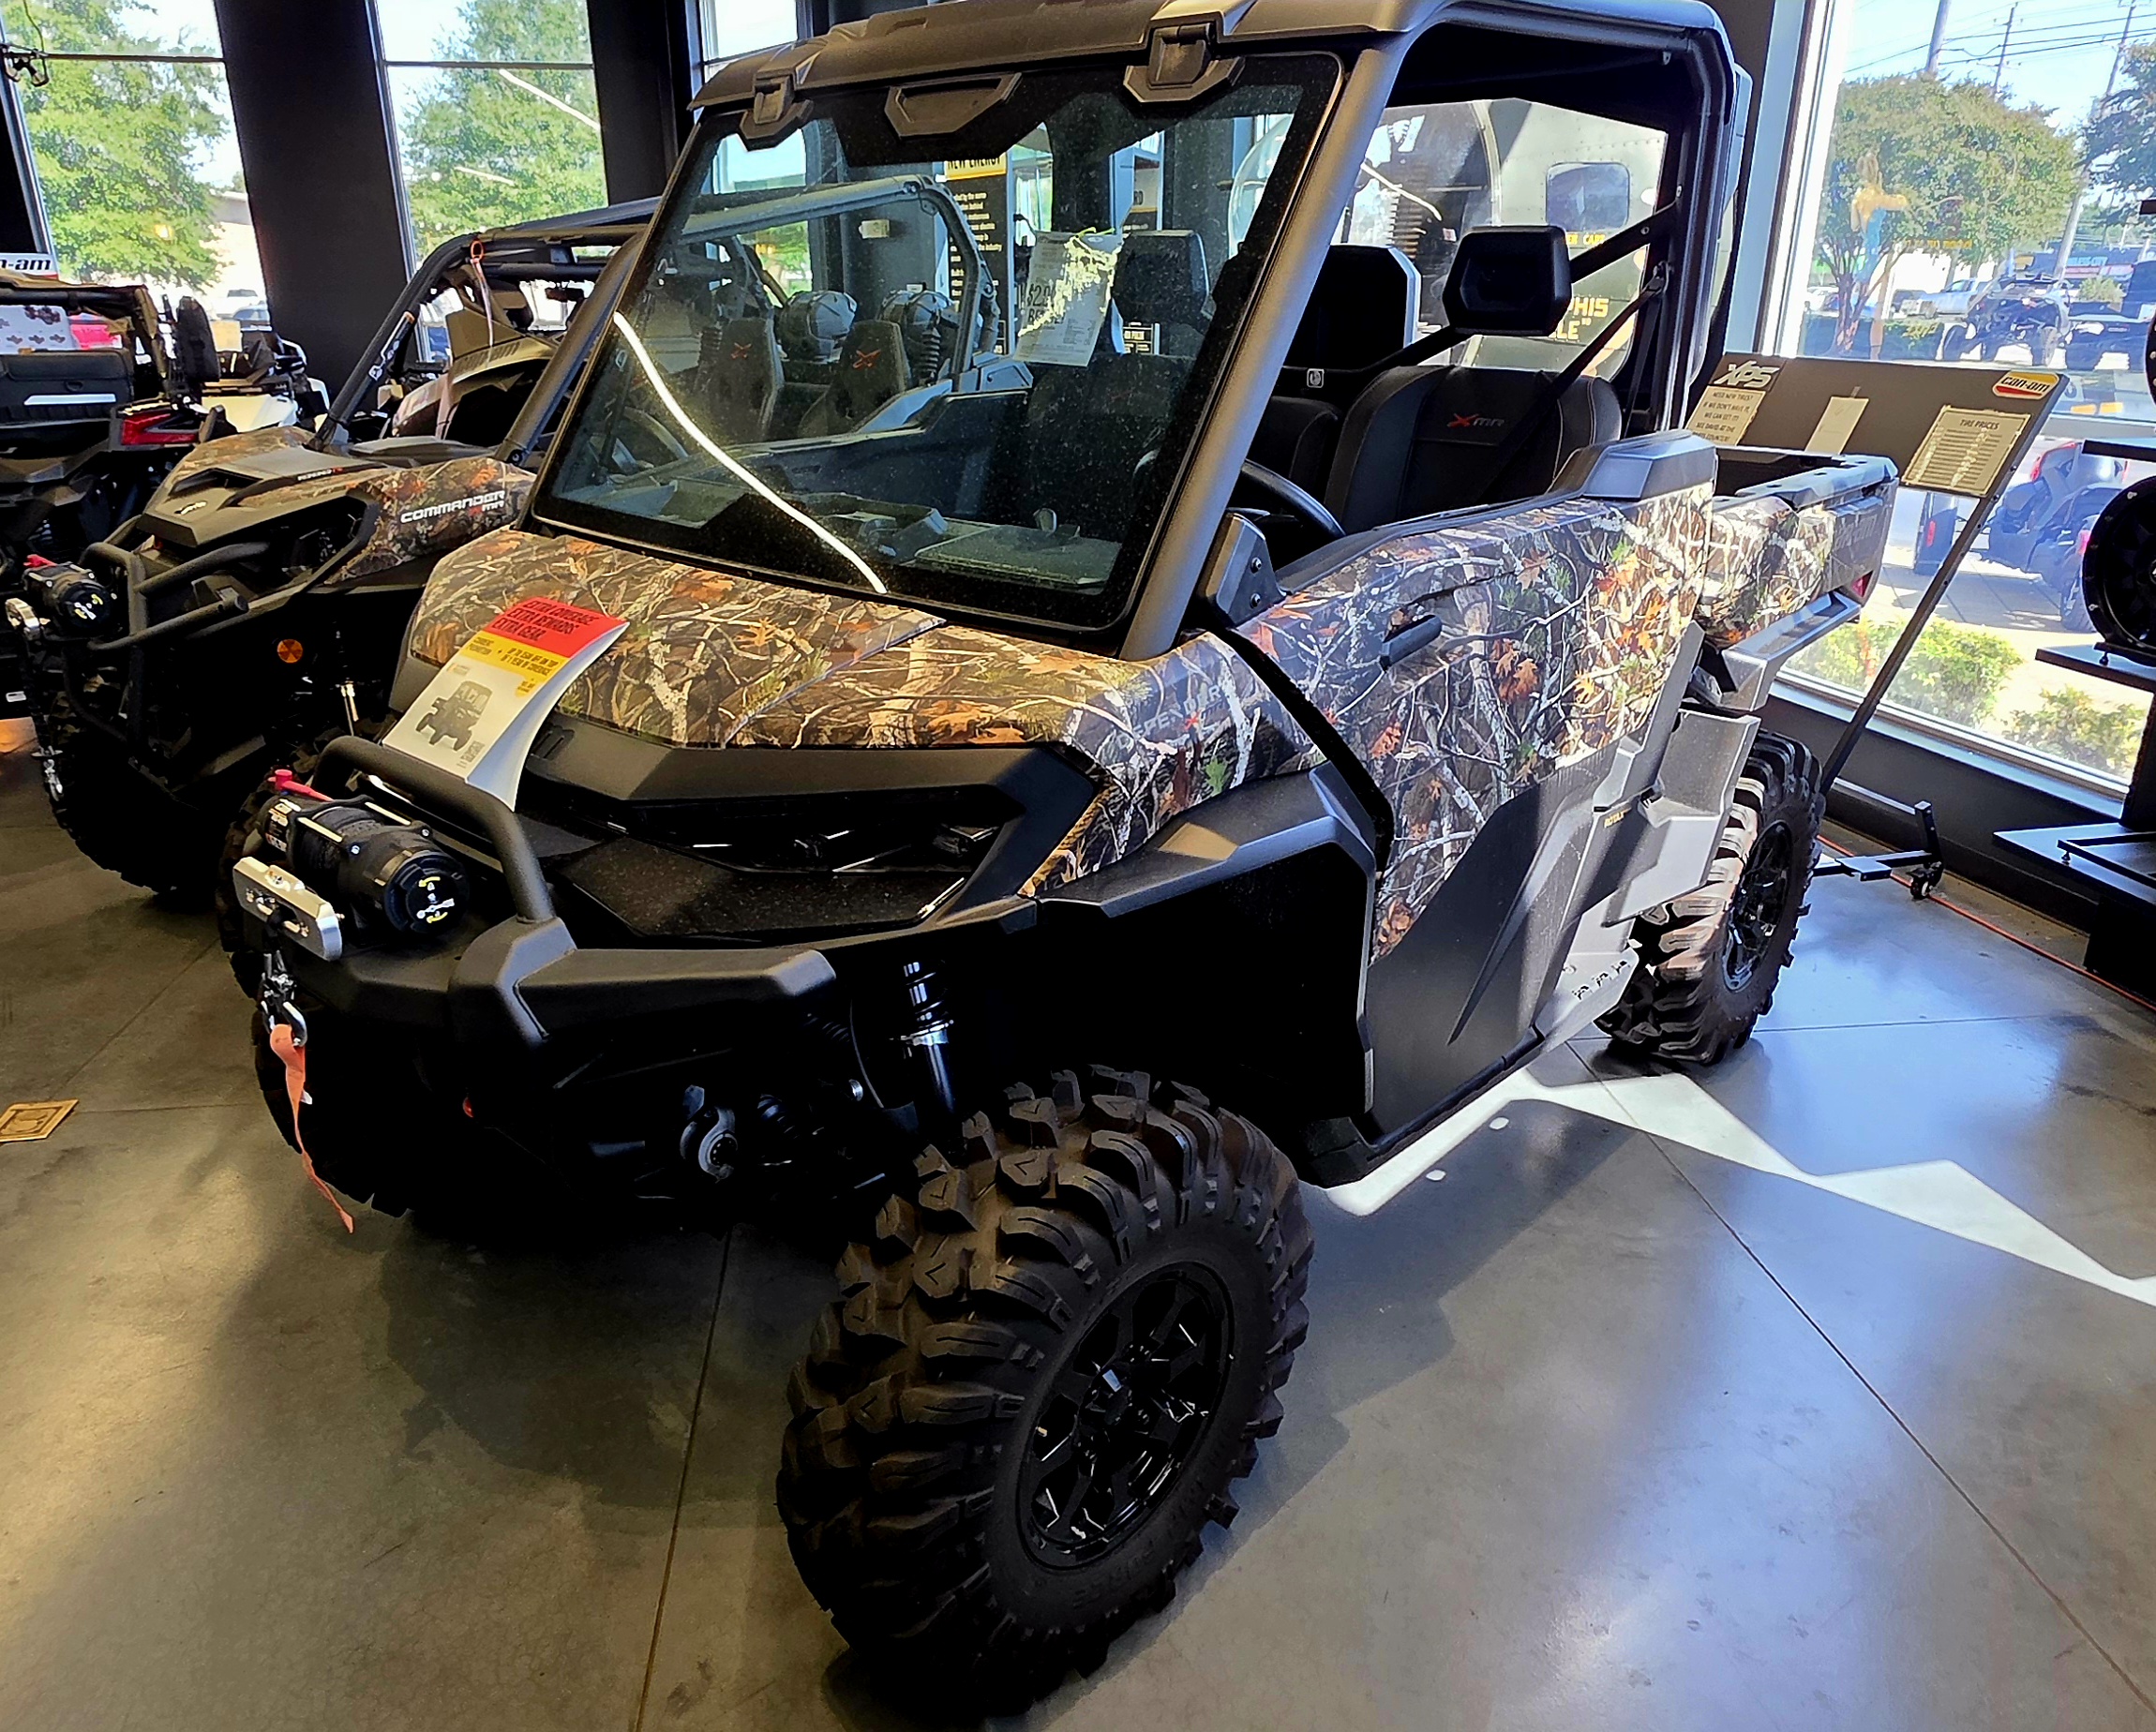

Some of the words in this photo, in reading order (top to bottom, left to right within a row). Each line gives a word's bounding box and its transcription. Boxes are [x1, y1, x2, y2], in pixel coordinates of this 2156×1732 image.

[1569, 296, 1610, 318] HIS
[1959, 419, 1975, 427] TIRE
[1974, 420, 2000, 430] PRICES
[400, 490, 506, 524] COMMANDER
[506, 608, 541, 623] EXTRA
[523, 600, 558, 614] EXTRA
[549, 607, 600, 626] COVERAGE
[491, 619, 525, 635] EXTRA
